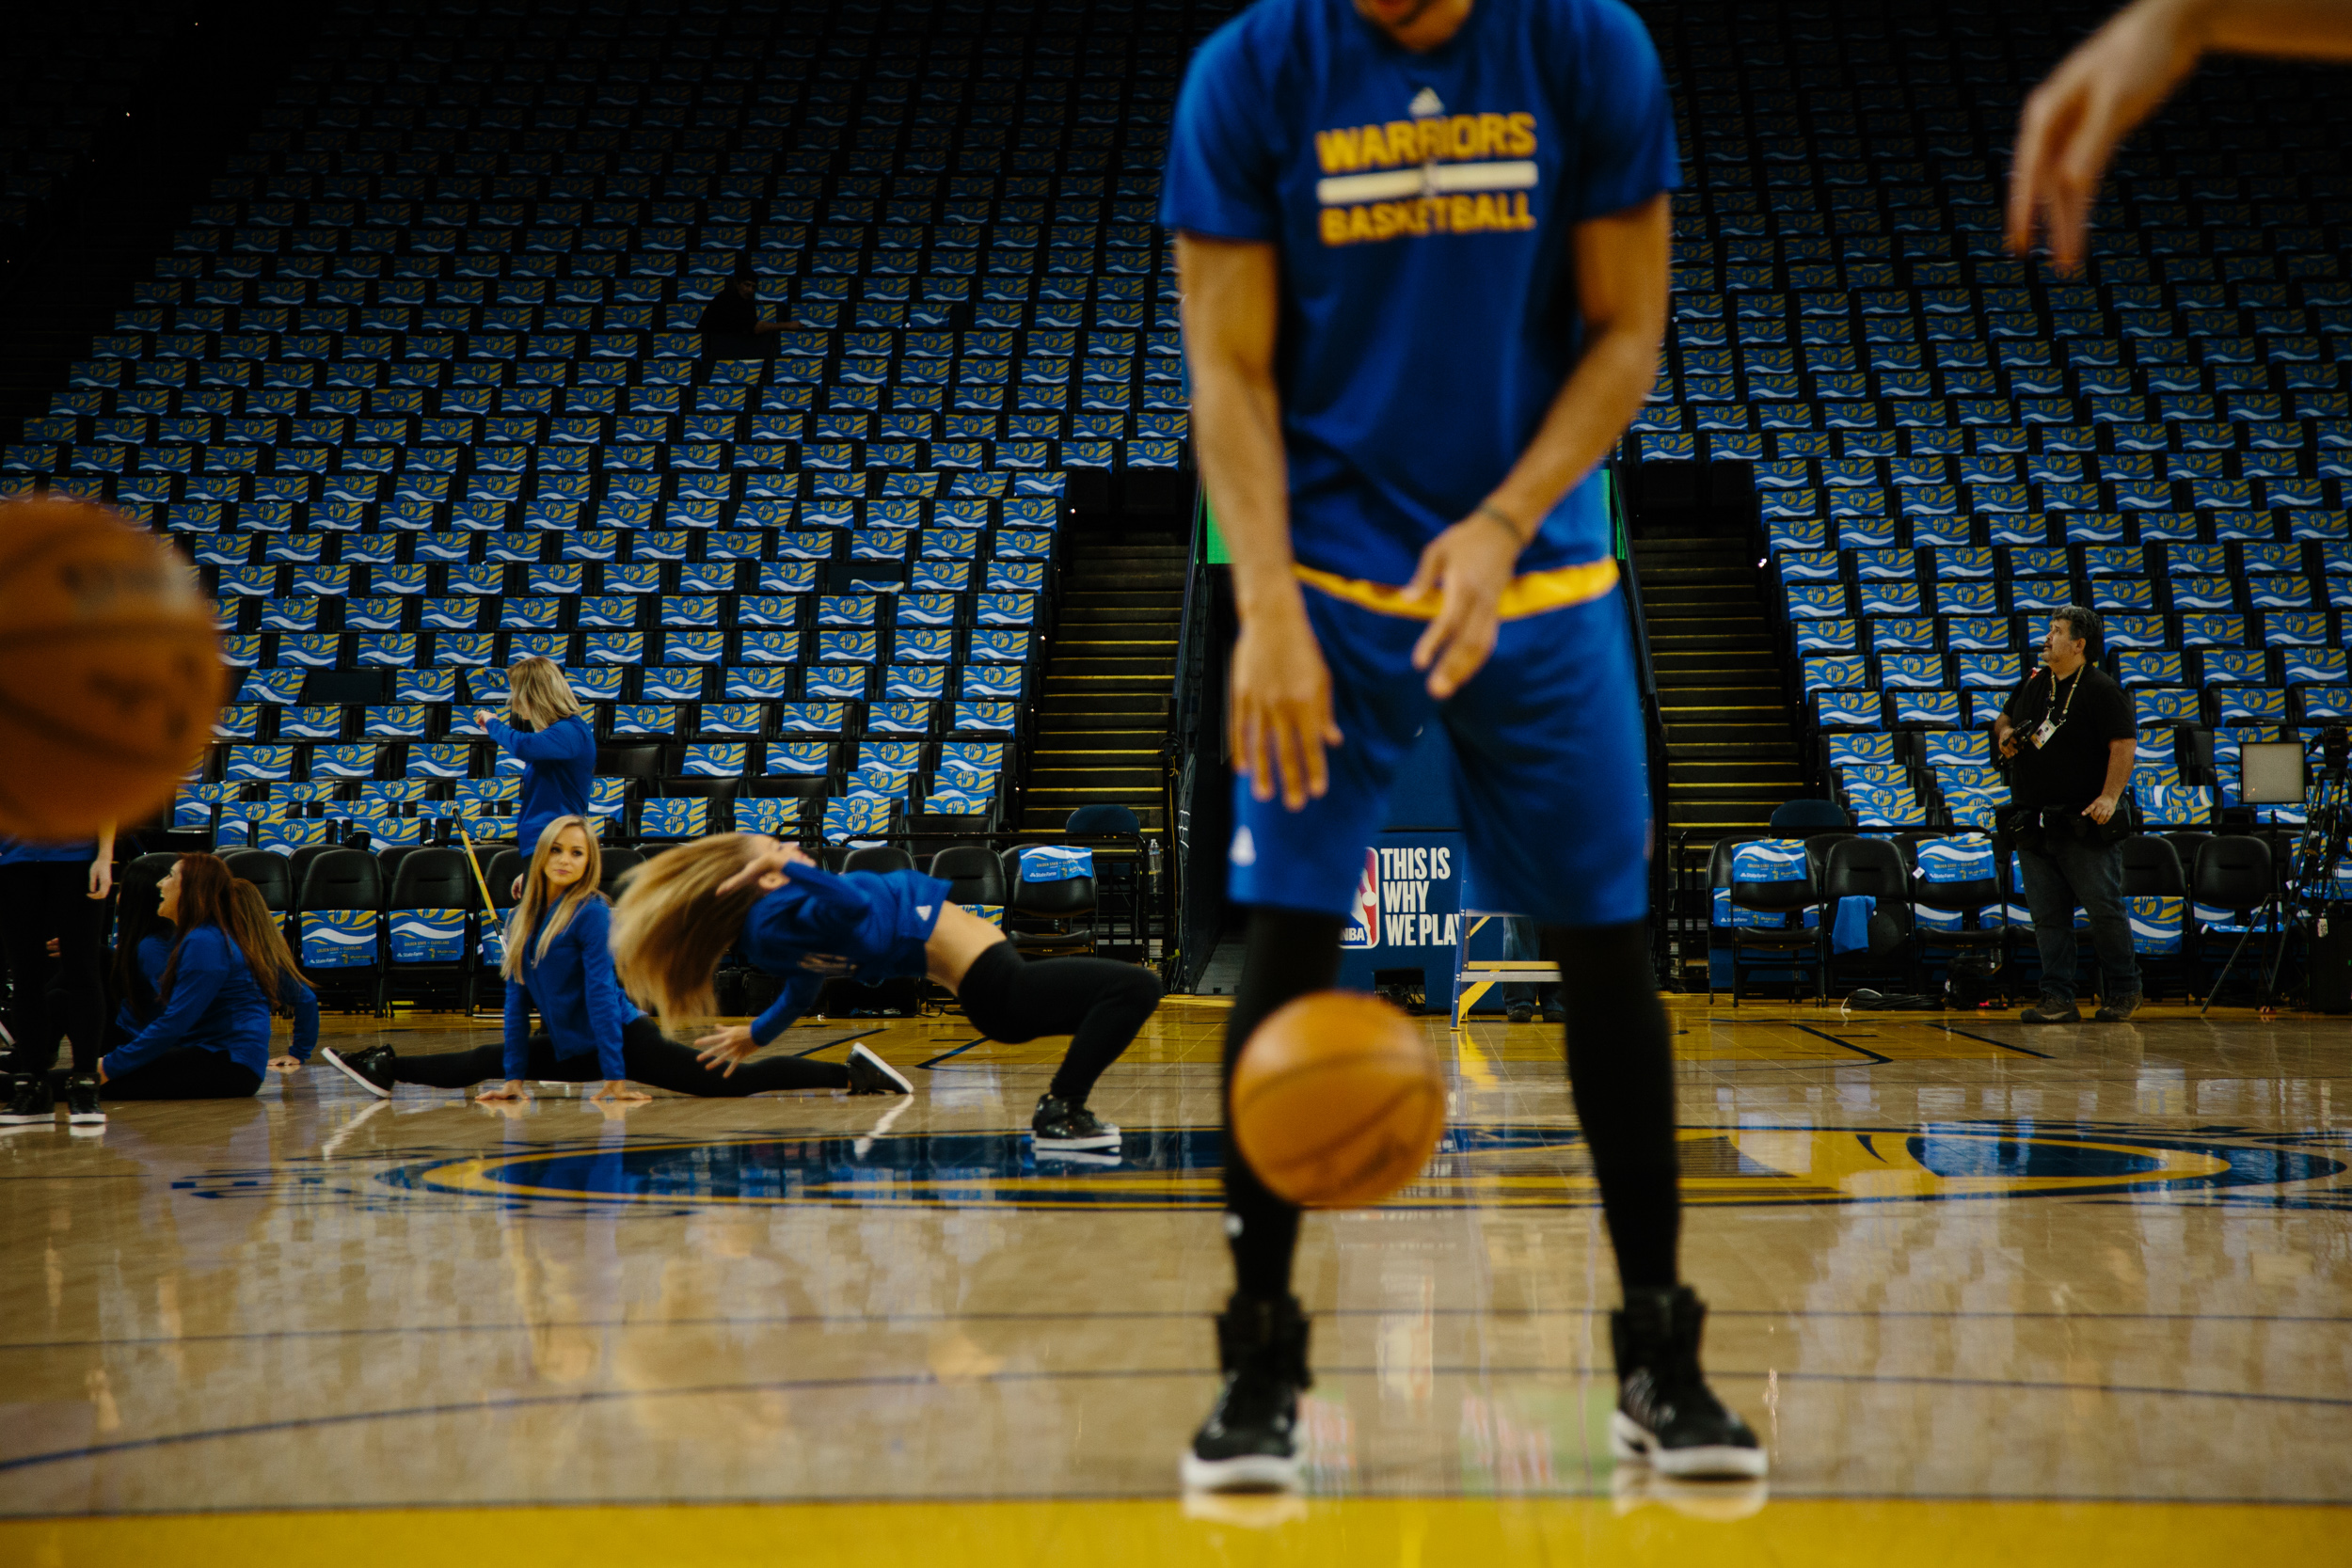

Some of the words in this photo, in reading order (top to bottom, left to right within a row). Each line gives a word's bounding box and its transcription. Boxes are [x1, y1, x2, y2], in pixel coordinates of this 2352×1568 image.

[1316, 112, 1538, 173] WARRIORS
[1320, 192, 1537, 247] BASKETBALL
[1380, 847, 1427, 879] THIS
[1430, 847, 1451, 879] IS
[1383, 881, 1429, 912] WHY
[1342, 927, 1365, 941] NBA
[1385, 914, 1416, 945] WE
